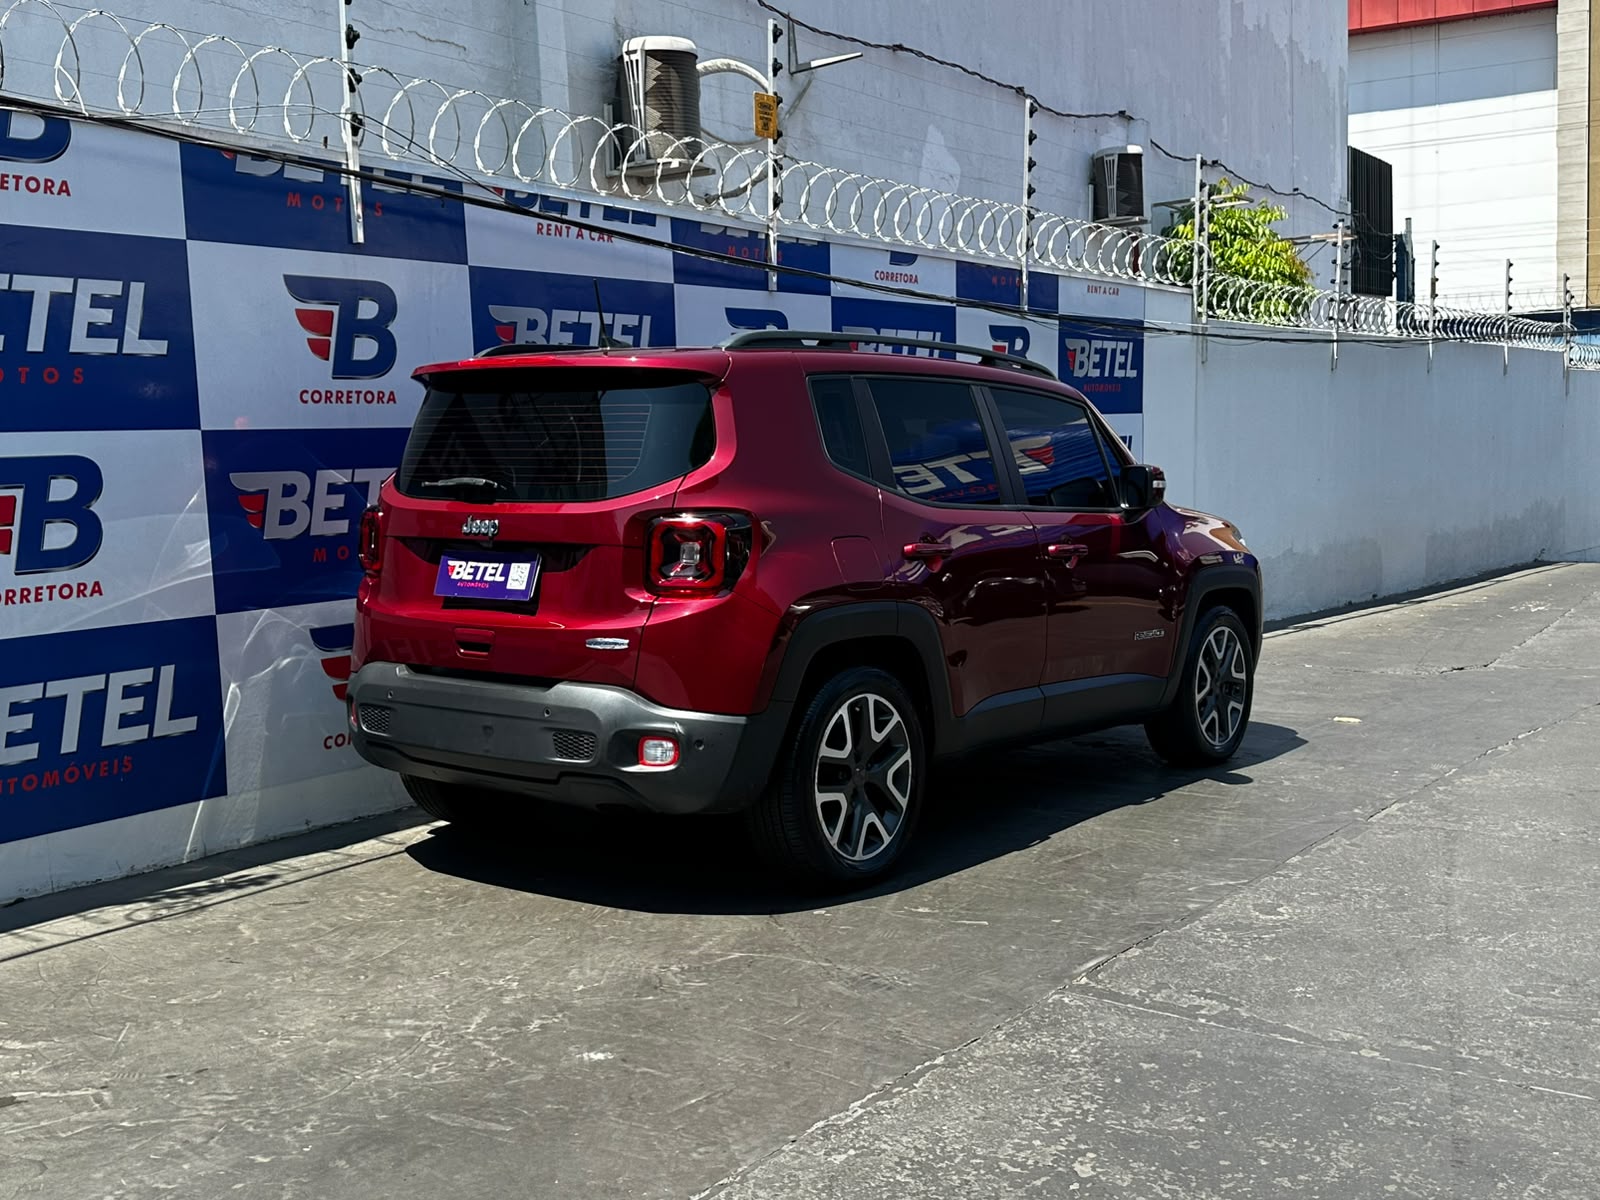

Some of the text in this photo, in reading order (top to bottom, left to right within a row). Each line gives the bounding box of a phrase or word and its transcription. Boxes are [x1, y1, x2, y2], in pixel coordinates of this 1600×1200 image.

[287, 192, 383, 216] MOTS
[536, 222, 571, 238] RENT
[575, 227, 585, 240] A
[728, 245, 783, 262] MOTS
[874, 270, 919, 285] CORRETORA
[1087, 284, 1102, 295] RENT
[1108, 287, 1120, 296] CAR
[0, 274, 168, 357] TEL
[1065, 338, 1137, 378] BETEL
[0, 367, 84, 385] TOS
[299, 389, 397, 405] CORRETORA
[461, 516, 499, 537] Jeep
[447, 560, 505, 582] BETEL
[0, 581, 103, 605] RRETORA
